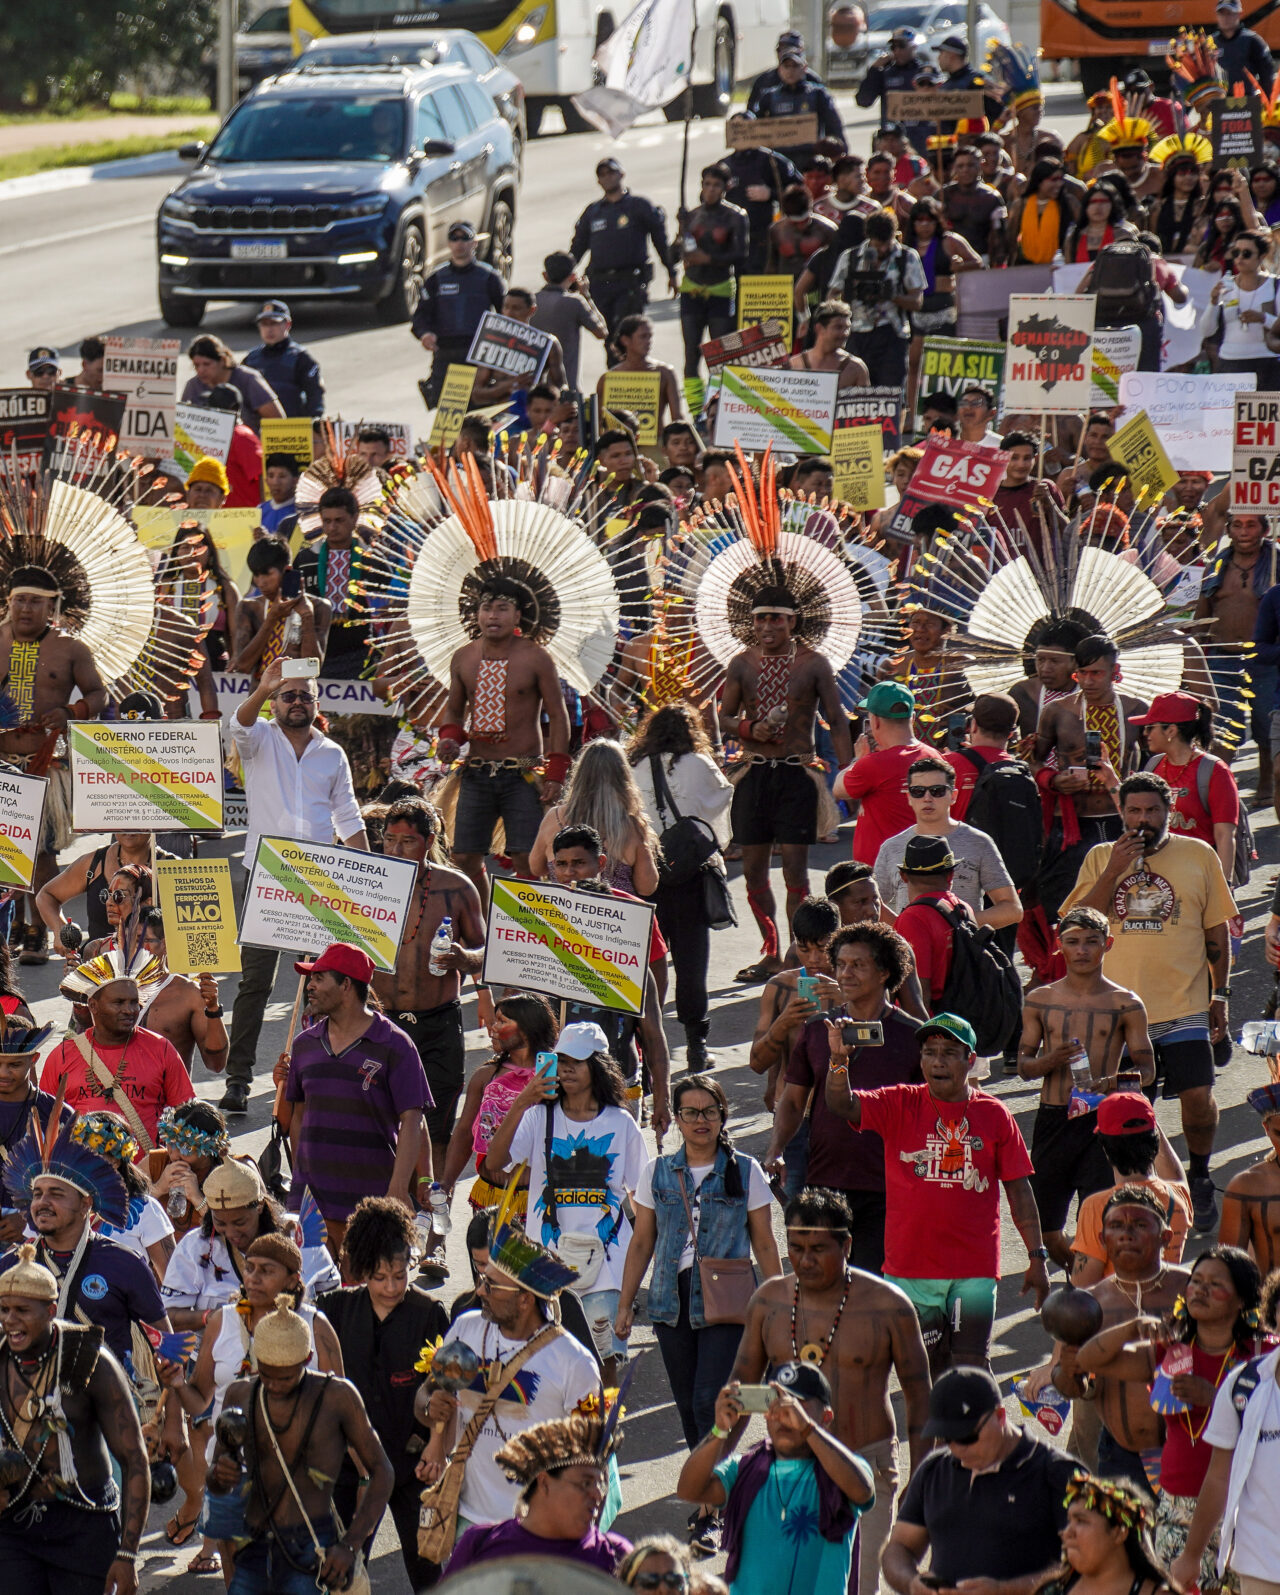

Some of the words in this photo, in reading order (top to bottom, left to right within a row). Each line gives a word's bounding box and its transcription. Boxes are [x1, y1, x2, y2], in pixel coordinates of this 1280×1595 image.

[1222, 120, 1253, 133] FORA
[485, 316, 548, 348] DEMARCAÇÃO
[1013, 331, 1087, 350] DEMARCAÇÃO
[476, 341, 537, 374] FUTURO
[1040, 346, 1048, 360] é
[106, 357, 176, 378] DEMARCAÇÃO
[924, 351, 998, 379] BRASIL
[1012, 360, 1085, 381] MÍNIMO
[136, 382, 145, 398] é
[723, 403, 763, 415] TERRA
[765, 406, 830, 420] PROTEGIDA
[1236, 422, 1276, 446] EM
[930, 454, 991, 487] GÁS
[945, 480, 957, 494] é
[1235, 481, 1261, 504] NO
[94, 732, 145, 741] GOVERNO
[149, 732, 197, 741] FEDERAL
[96, 746, 143, 754] MINISTÉRIO
[161, 746, 195, 755] JUSTIÇA
[78, 773, 128, 784] TERRA
[131, 772, 216, 784] PROTEGIDA
[2, 808, 34, 823] Indígenas
[280, 848, 335, 867] GOVERNO
[337, 858, 389, 877] FEDERAL
[280, 861, 330, 879] MINISTÉRIO
[331, 873, 344, 882] DA
[346, 875, 384, 890] JUSTIÇA
[175, 884, 216, 892] DESTRUIÇÃO
[258, 870, 293, 884] Fundação
[294, 877, 325, 889] Nacional
[326, 884, 340, 892] dos
[341, 886, 364, 896] Povos
[366, 890, 401, 904] Indígenas
[176, 894, 219, 902] FERROGRÃO
[255, 885, 308, 906] TERRA
[309, 894, 399, 923] PROTEGIDA
[518, 890, 572, 910] GOVERNO
[575, 902, 626, 922] FEDERAL
[1116, 888, 1126, 915] CRAZY
[177, 902, 221, 922] NÃO
[519, 904, 568, 922] MINISTÉRIO
[570, 916, 583, 925] DA
[585, 919, 622, 935] JUSTIÇA
[498, 912, 532, 926] Fundação
[534, 920, 564, 932] Nacional
[566, 927, 579, 935] dos
[581, 930, 604, 941] Povos
[606, 935, 641, 950] Indígenas
[1124, 921, 1144, 929] BLACK
[1145, 921, 1162, 929] HILLS
[497, 926, 549, 948] TERRA
[551, 937, 640, 968] PROTEGIDA
[362, 1059, 382, 1090] 7
[556, 1191, 606, 1204] adidas
